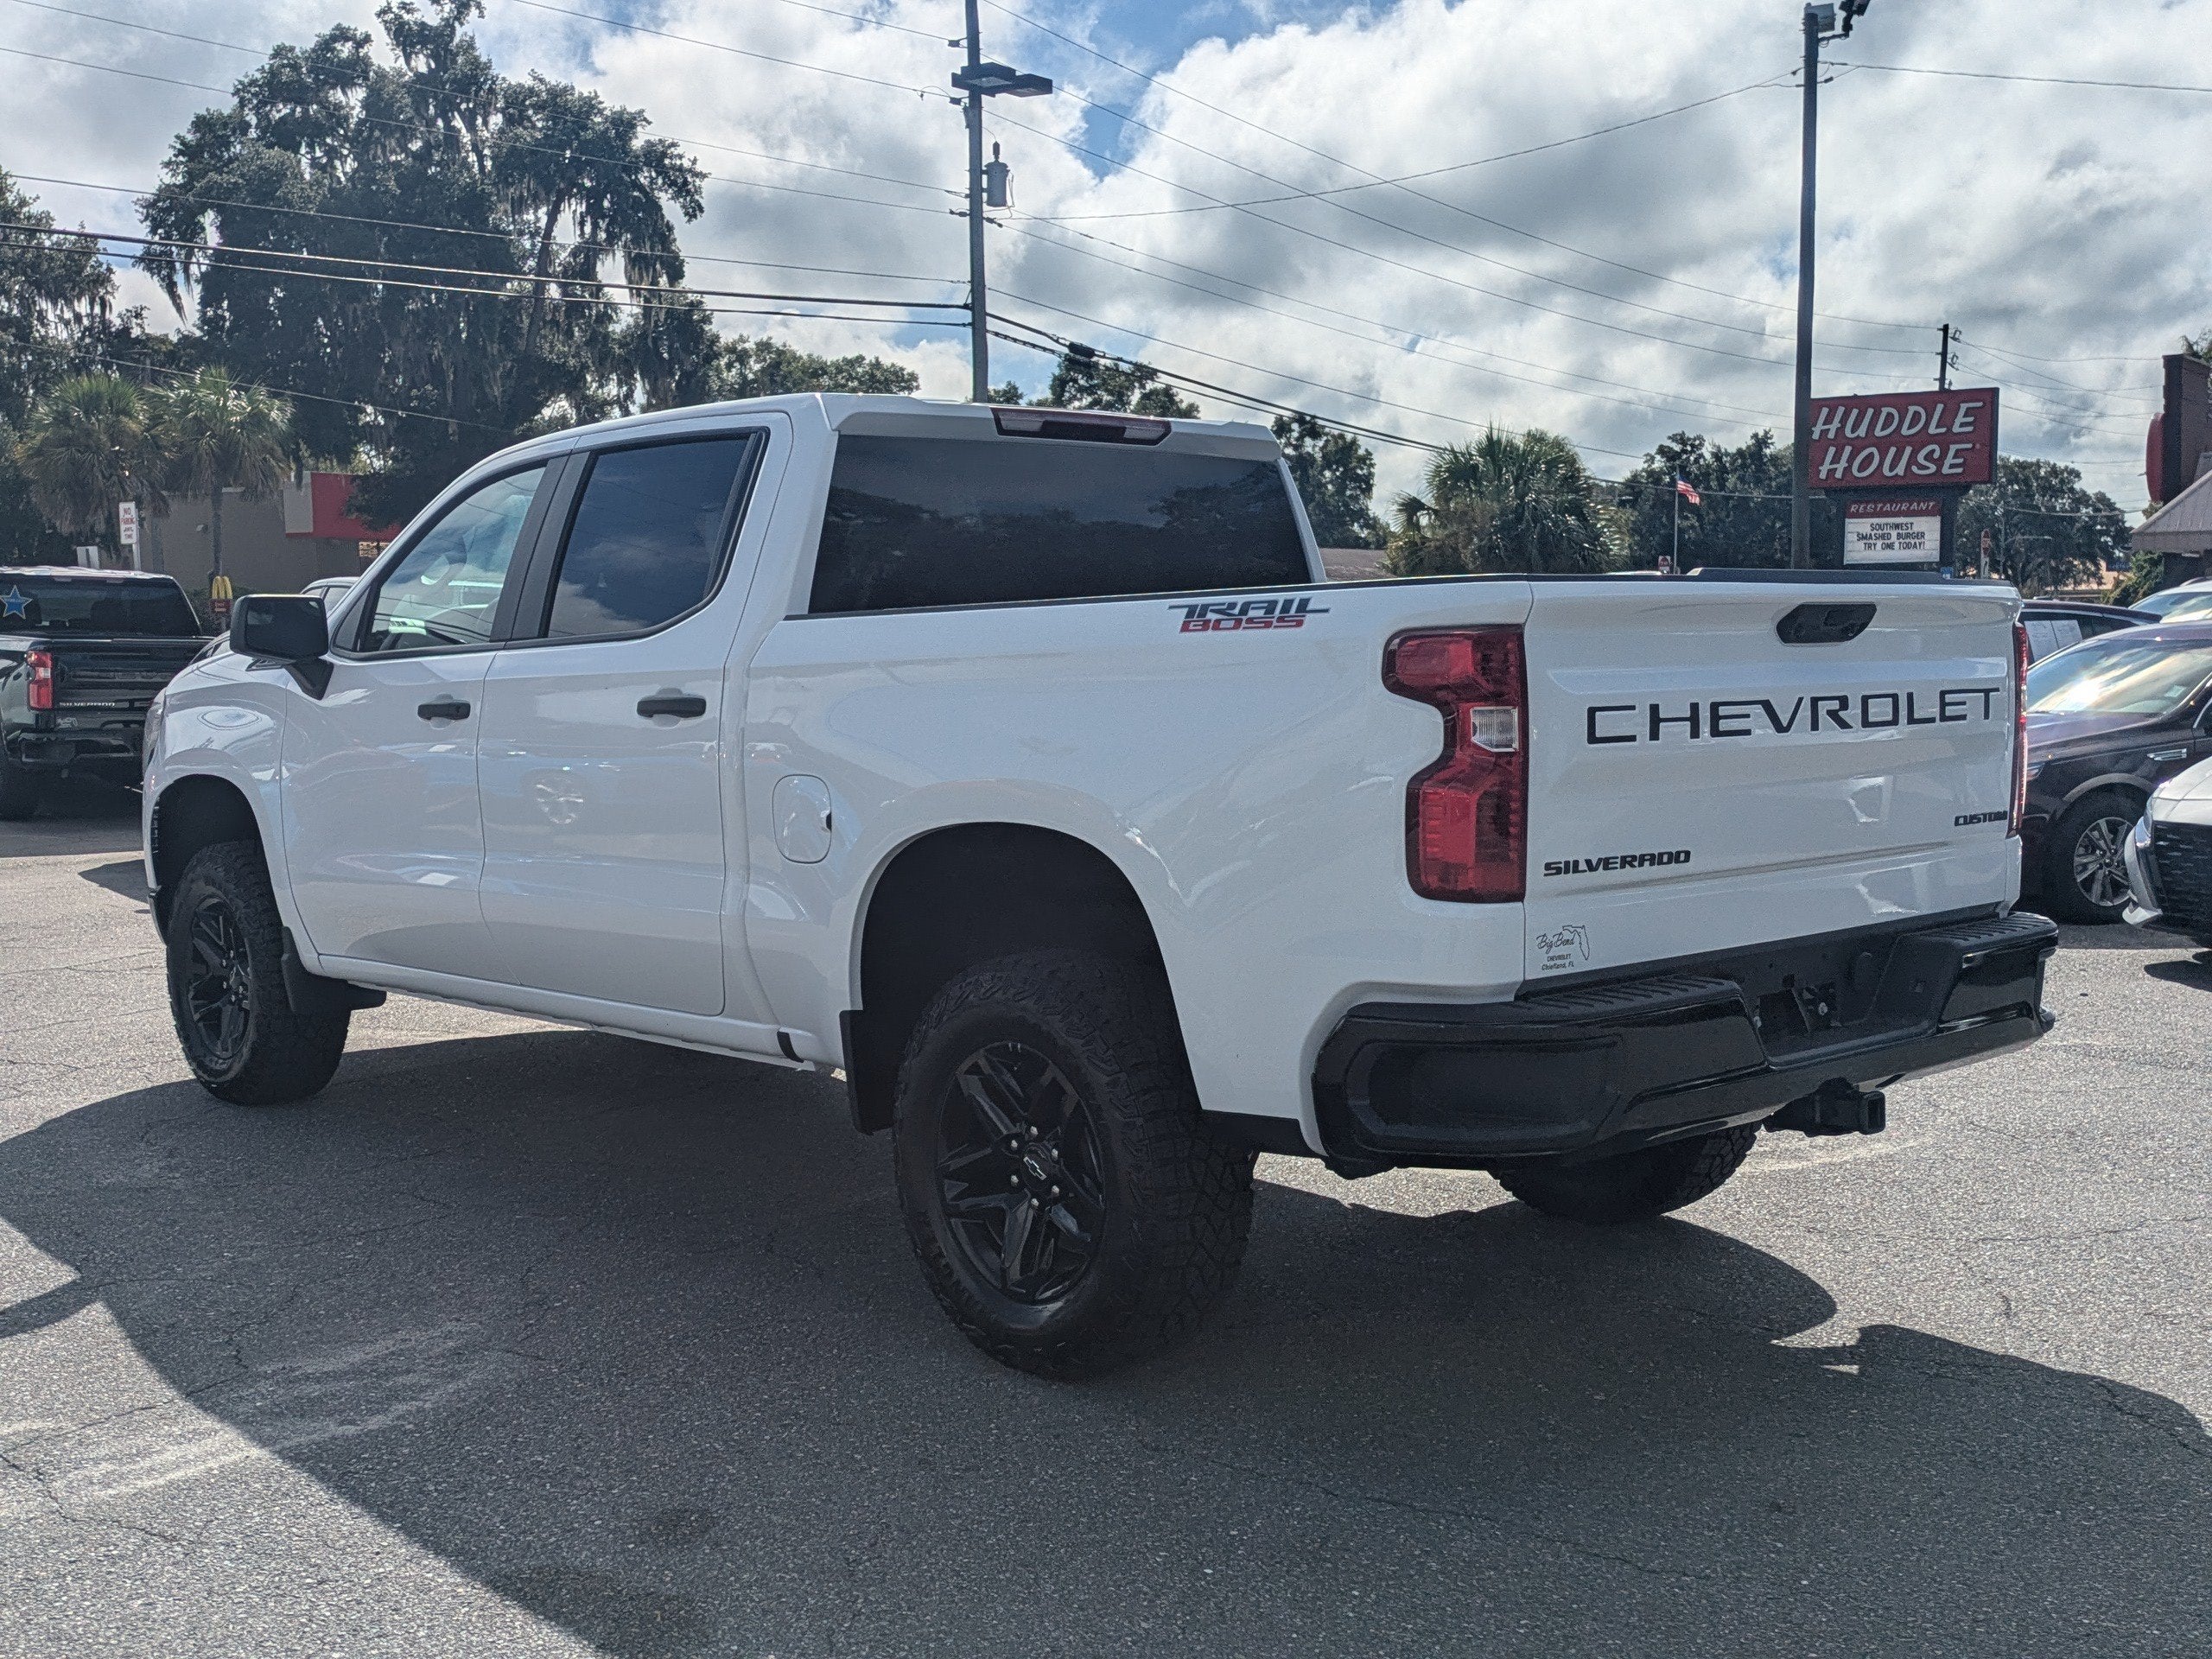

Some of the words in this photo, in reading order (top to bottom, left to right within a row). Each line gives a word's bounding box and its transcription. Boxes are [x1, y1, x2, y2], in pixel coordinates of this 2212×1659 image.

[1811, 401, 1984, 441] HUDDLE
[1818, 442, 1974, 480] HOUSE
[1850, 501, 1936, 513] RESTAURANT
[1856, 532, 1892, 542] SMASHED
[1896, 531, 1926, 541] BURGER
[1869, 522, 1915, 531] SOUTHWEST
[1863, 542, 1878, 550] TRY
[1880, 542, 1896, 550] ONE
[1897, 541, 1926, 550] TODAY!
[1166, 597, 1332, 620] TRAIL
[1179, 613, 1308, 633] BOSS
[1586, 686, 2001, 746] CHEVROLET
[1954, 810, 2009, 827] CUSTOM
[1542, 849, 1692, 877] SILVERADO
[1535, 933, 1554, 955] Big
[1552, 931, 1576, 948] Bend
[1547, 953, 1572, 962] CHEVROLET
